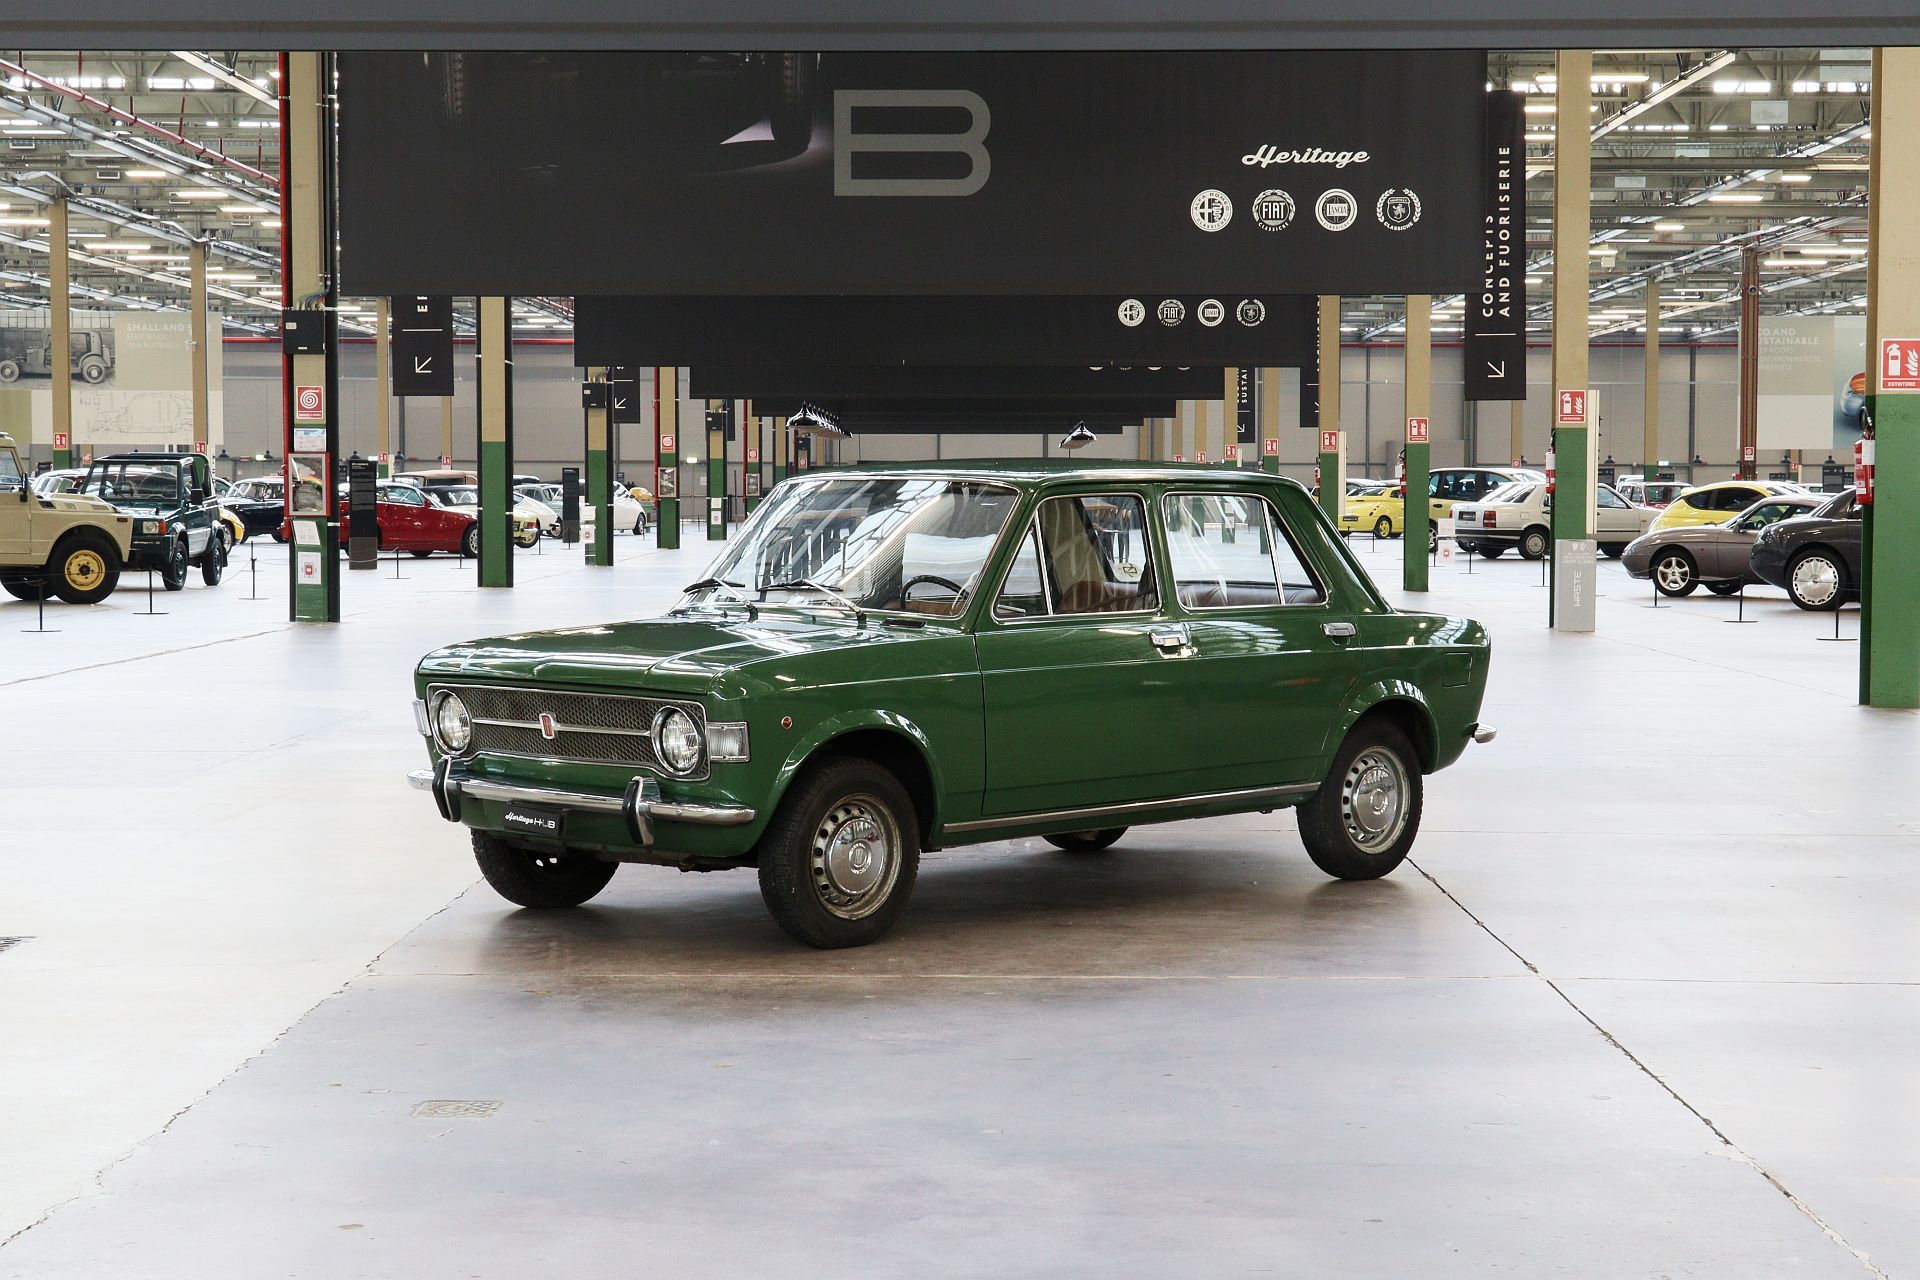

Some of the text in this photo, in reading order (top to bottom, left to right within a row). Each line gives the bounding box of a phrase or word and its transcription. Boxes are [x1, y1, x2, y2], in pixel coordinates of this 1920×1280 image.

[834, 89, 991, 197] B
[1241, 144, 1371, 169] Heritage
[1263, 202, 1286, 219] FIAT
[1328, 204, 1347, 216] LANCIA
[1384, 221, 1415, 231] CLASSICHE
[1498, 147, 1511, 317] AND FUORISERIE
[1163, 308, 1179, 319] FIAT
[126, 323, 160, 332] SMALL
[162, 323, 185, 332] AND
[1773, 327, 1797, 337] AND
[1573, 569, 1582, 608] WASTE
